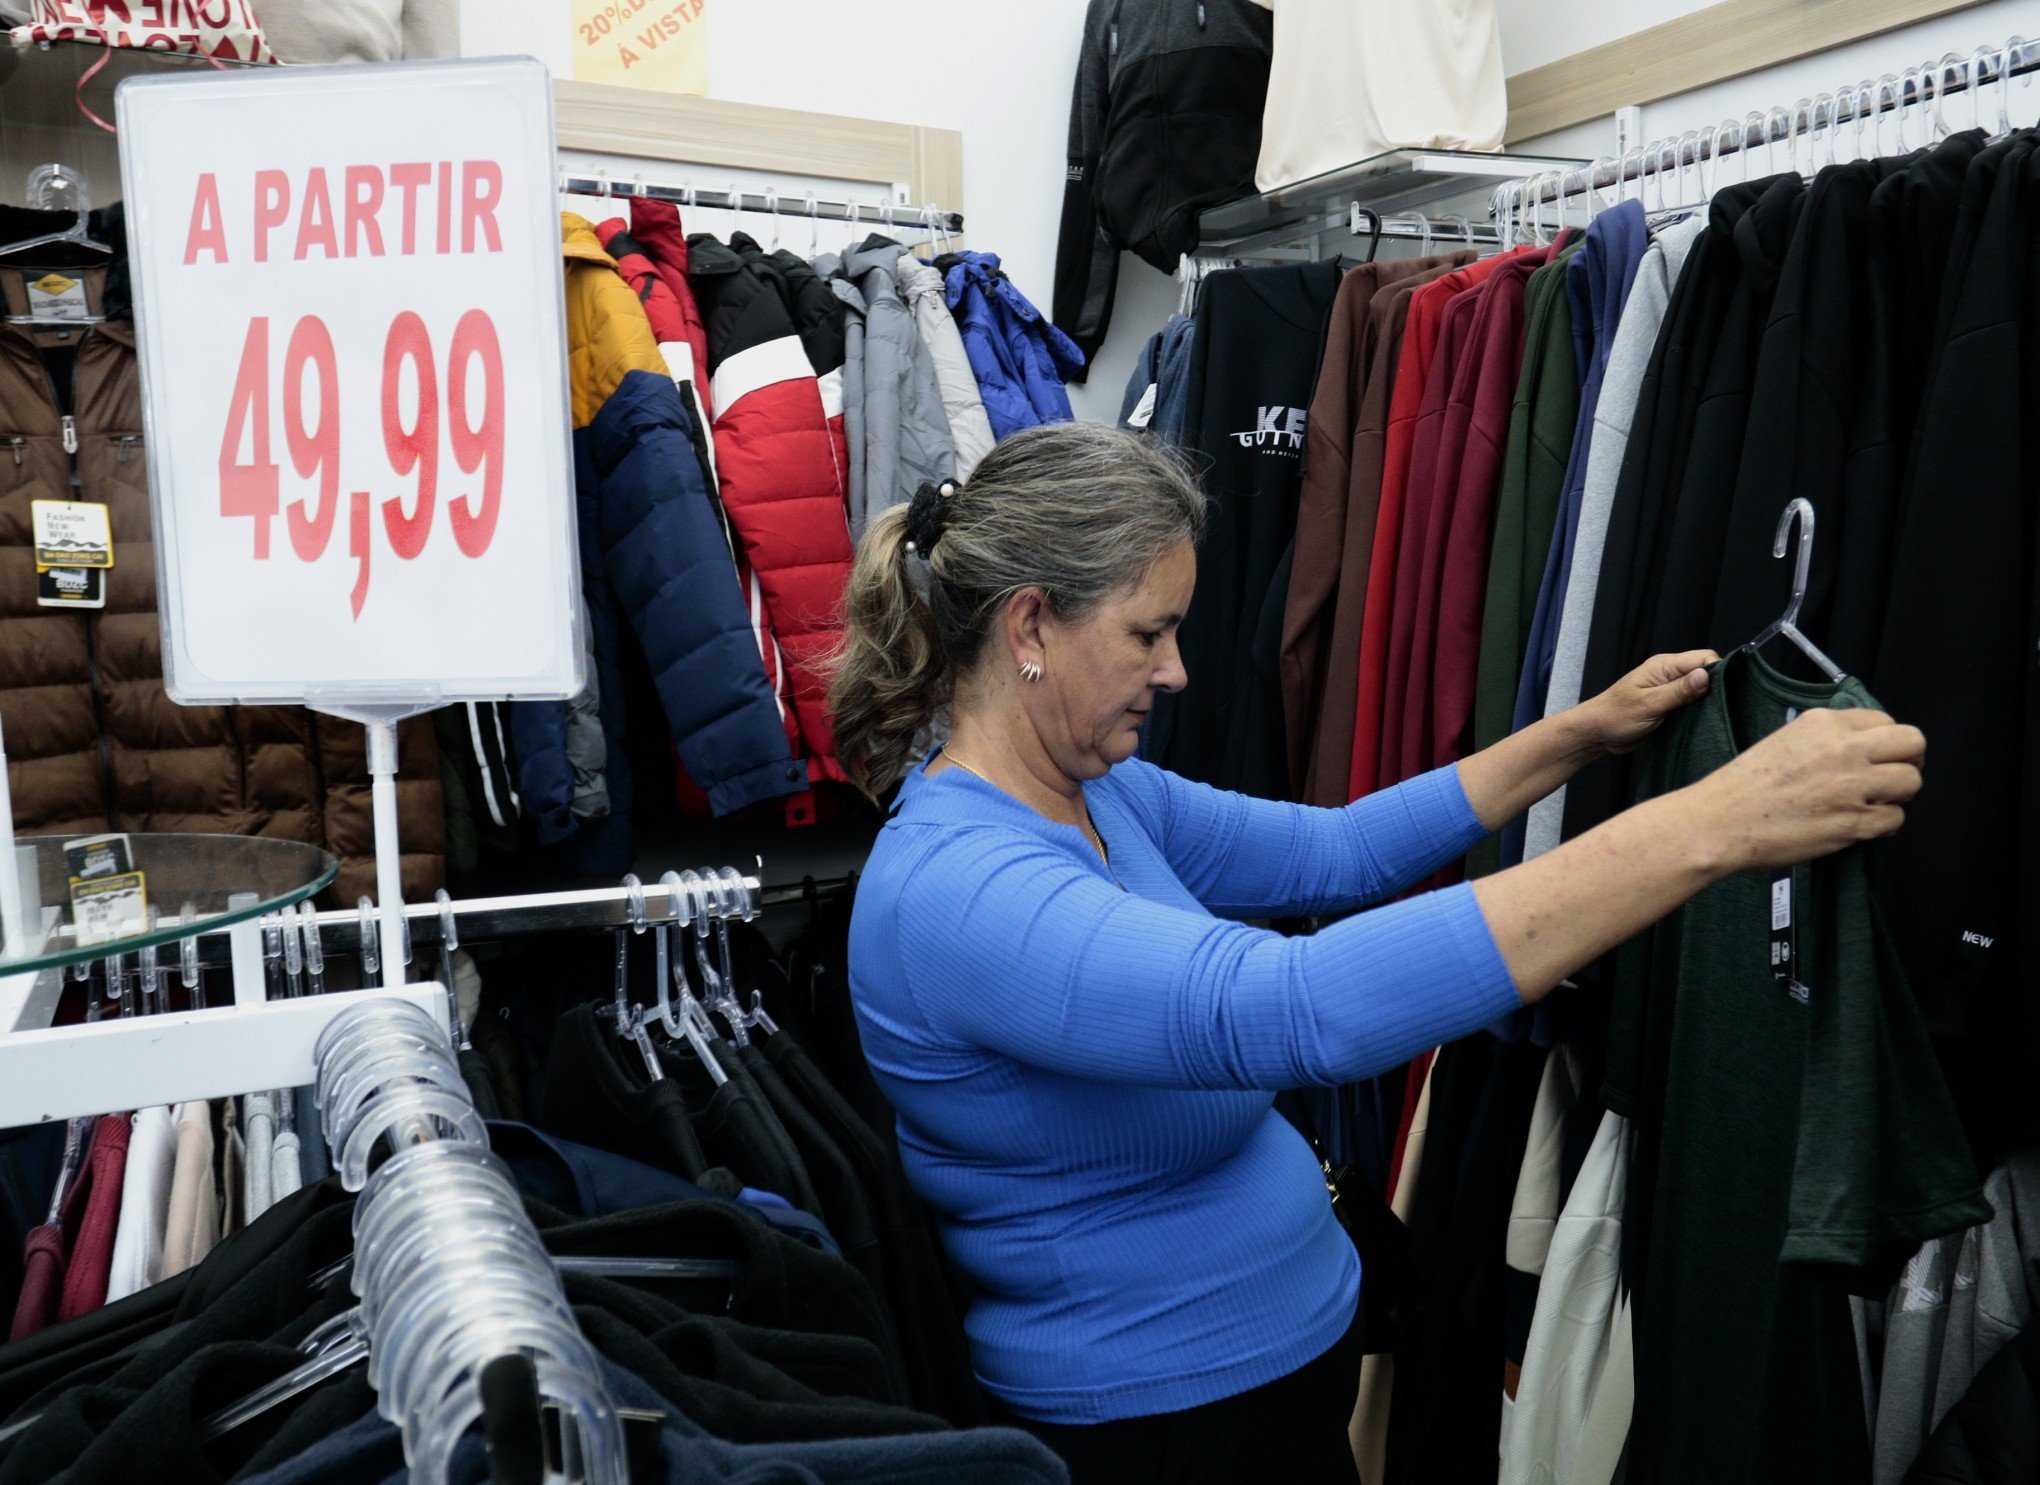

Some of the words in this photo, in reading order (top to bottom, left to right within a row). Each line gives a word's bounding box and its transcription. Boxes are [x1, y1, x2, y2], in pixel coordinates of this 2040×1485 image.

[635, 0, 704, 49] VISTA
[183, 172, 229, 265] A
[254, 160, 503, 262] PARTIR
[219, 308, 505, 623] 49,99
[1962, 930, 1994, 948] NEW
